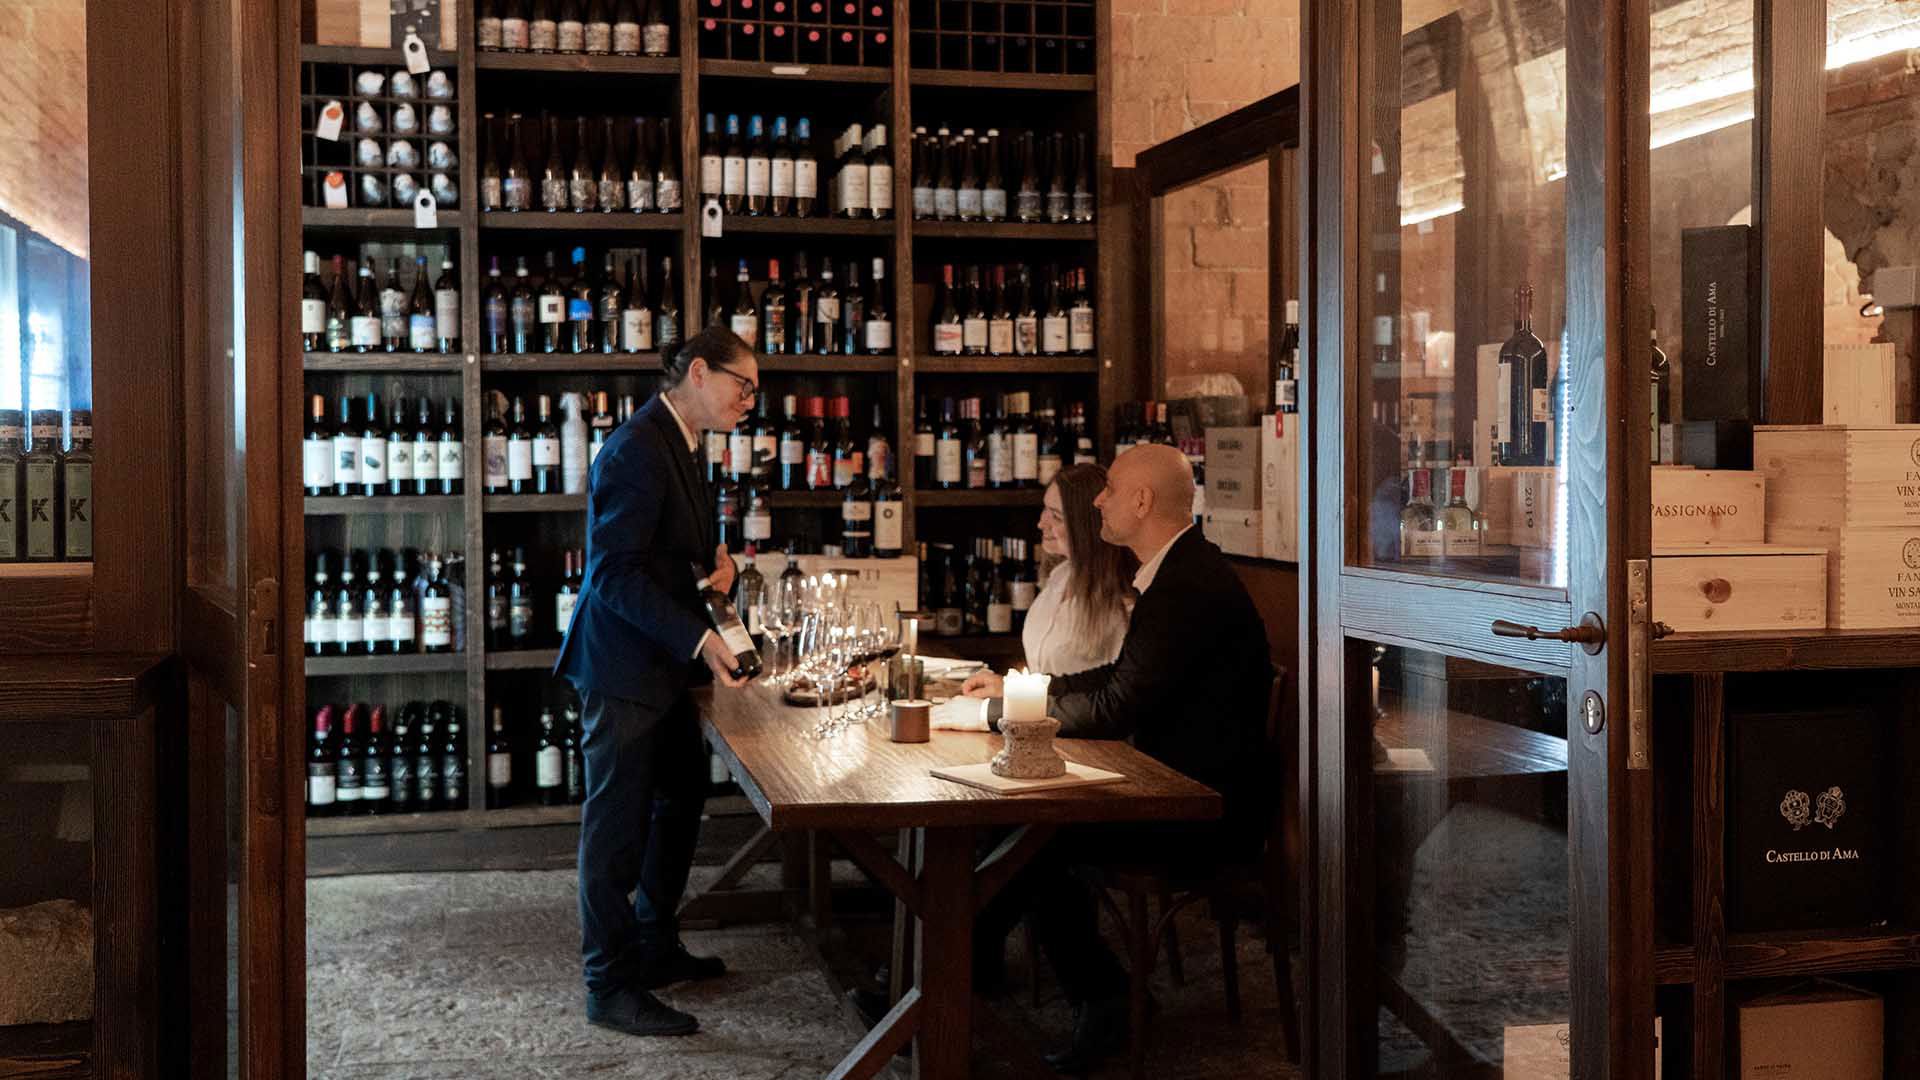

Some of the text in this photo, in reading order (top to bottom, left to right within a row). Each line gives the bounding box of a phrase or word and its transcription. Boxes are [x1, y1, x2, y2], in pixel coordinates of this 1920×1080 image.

[1706, 281, 1717, 305] AMA
[1706, 318, 1717, 367] CASTELLO
[1896, 485, 1914, 496] VIN
[32, 498, 49, 522] K
[70, 498, 88, 522] K
[1888, 586, 1906, 597] VIN
[1766, 847, 1859, 863] CASTELLO DI AMA
